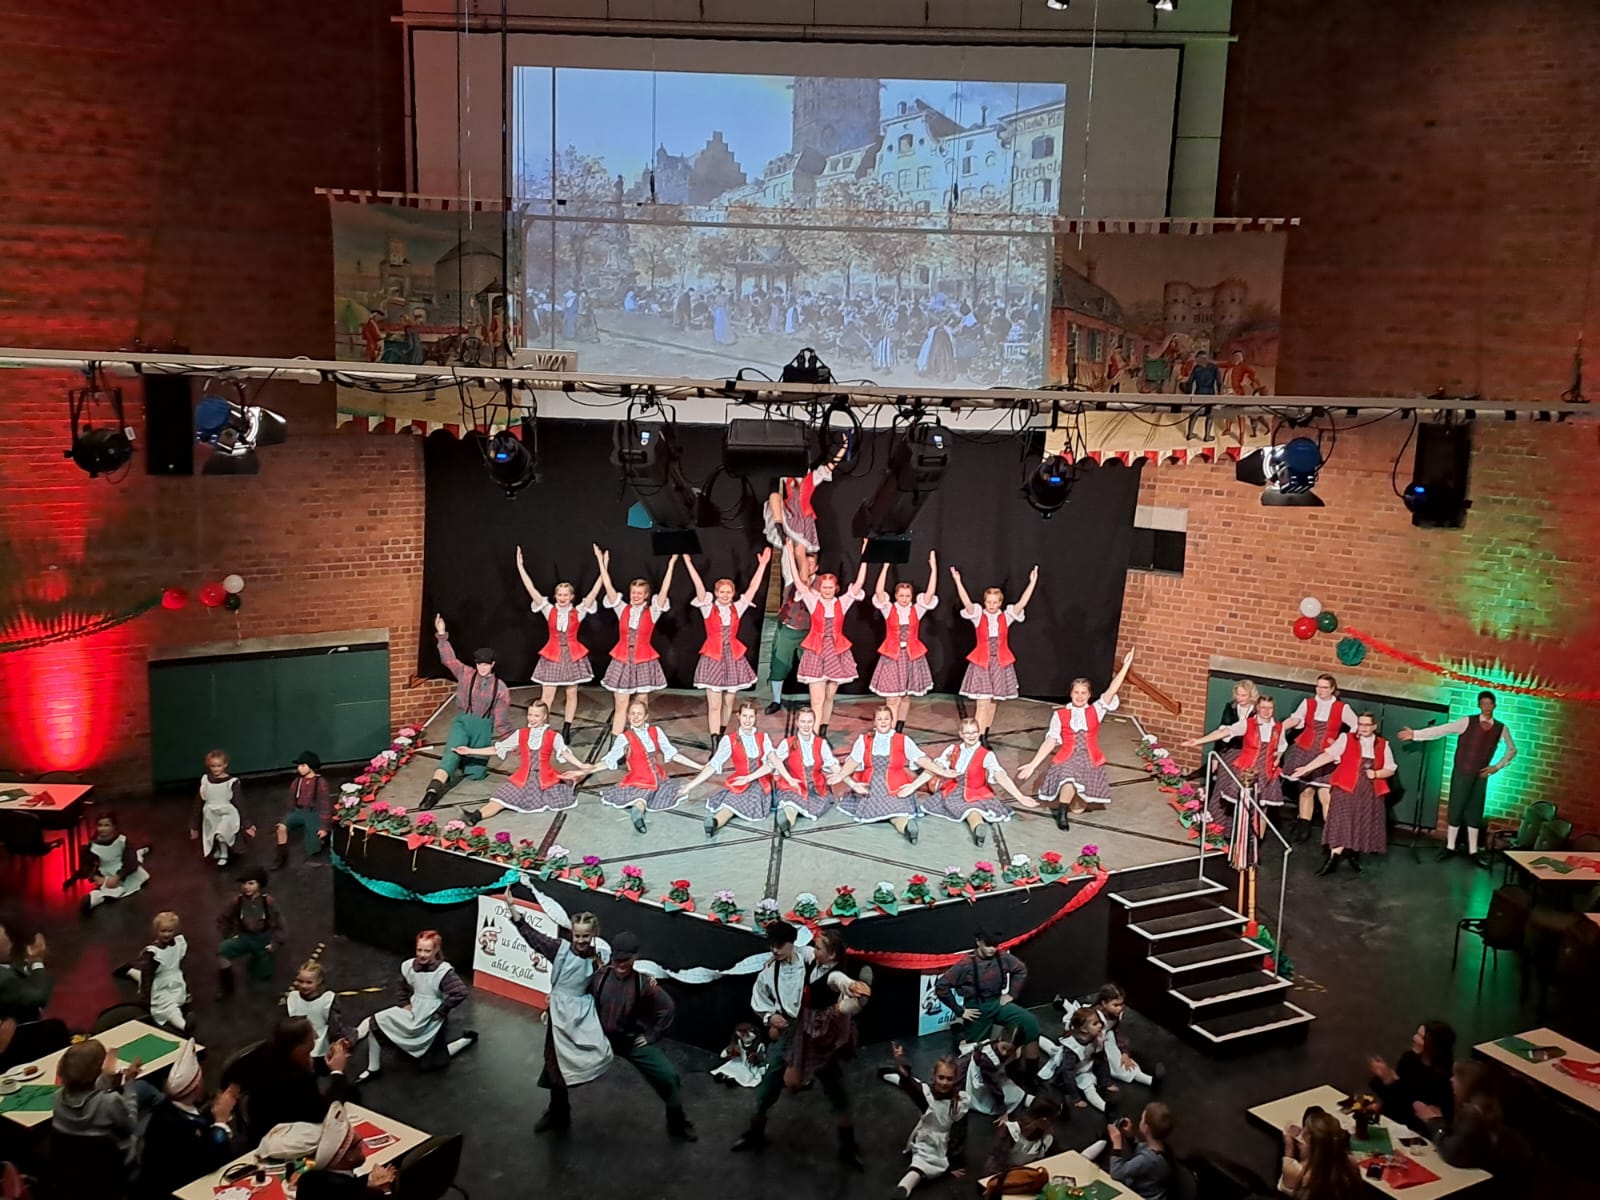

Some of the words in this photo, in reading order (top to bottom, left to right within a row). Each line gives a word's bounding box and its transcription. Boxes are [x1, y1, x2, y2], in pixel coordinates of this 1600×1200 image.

[501, 938, 511, 948] us
[512, 937, 527, 953] dem
[491, 959, 509, 972] ahle
